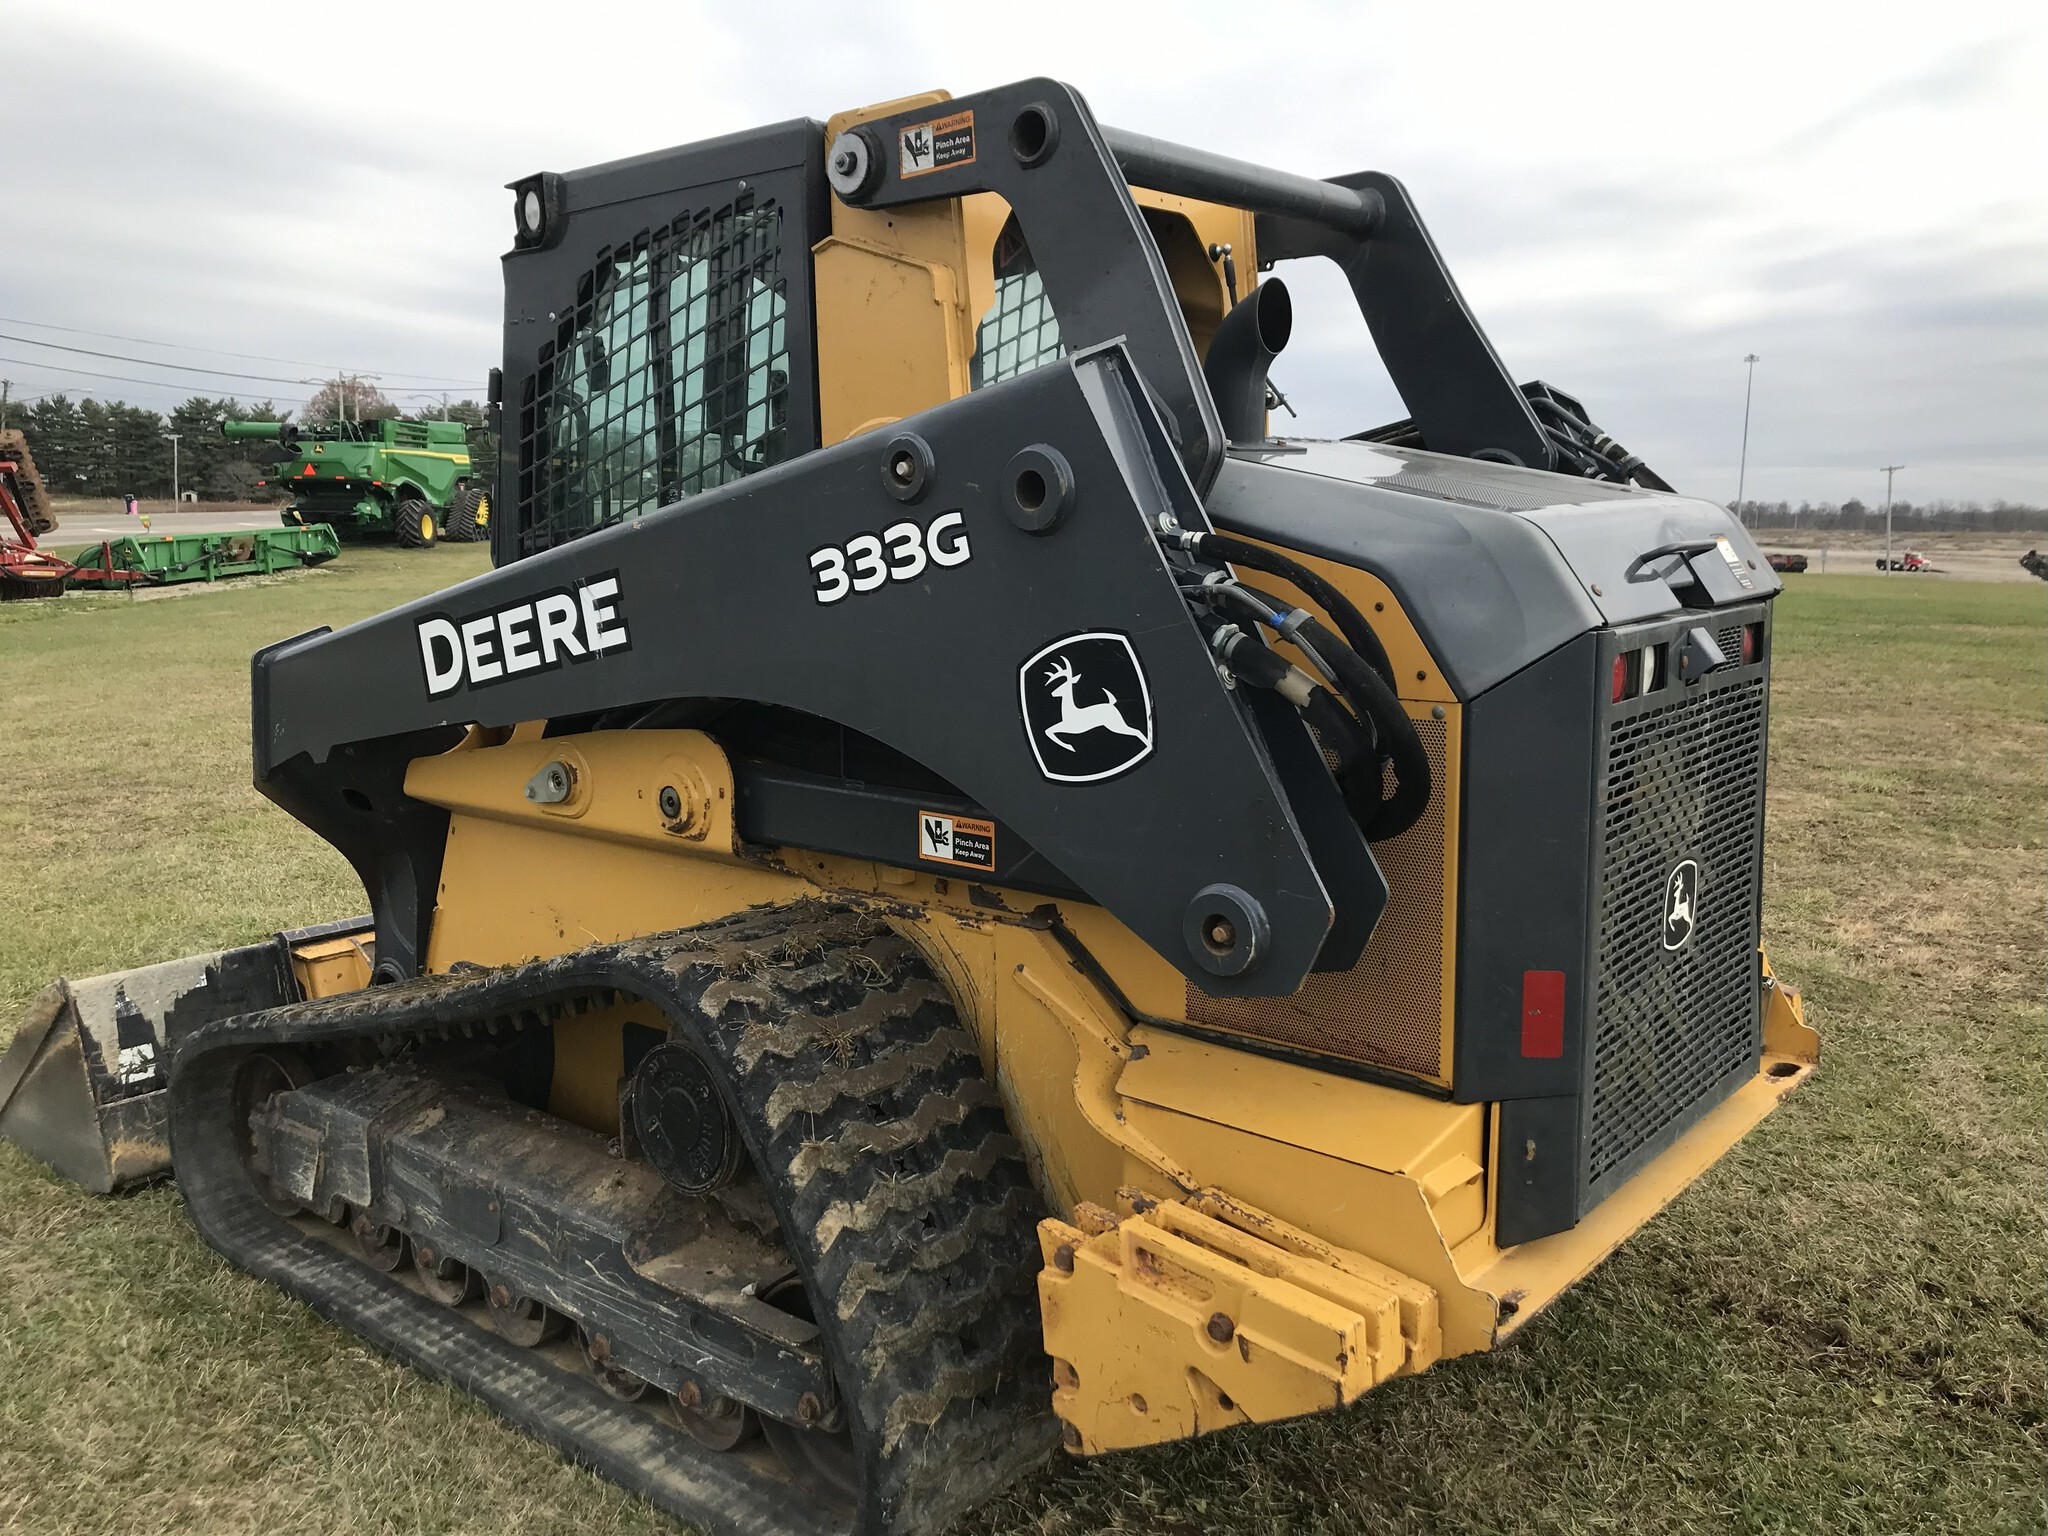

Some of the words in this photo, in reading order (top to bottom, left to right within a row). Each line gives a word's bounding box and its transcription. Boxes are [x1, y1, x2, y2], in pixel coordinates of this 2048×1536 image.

[941, 115, 971, 130] WARNING
[935, 138, 954, 150] Pinch
[954, 135, 971, 145] Area
[935, 151, 950, 160] Keep
[950, 147, 966, 157] Away
[810, 512, 971, 603] 333G
[418, 577, 627, 694] DEERE
[961, 822, 991, 833] WARNING
[955, 837, 974, 848] Pinch
[974, 841, 990, 851] Area
[954, 848, 970, 857] Keep
[969, 850, 985, 861] Away
